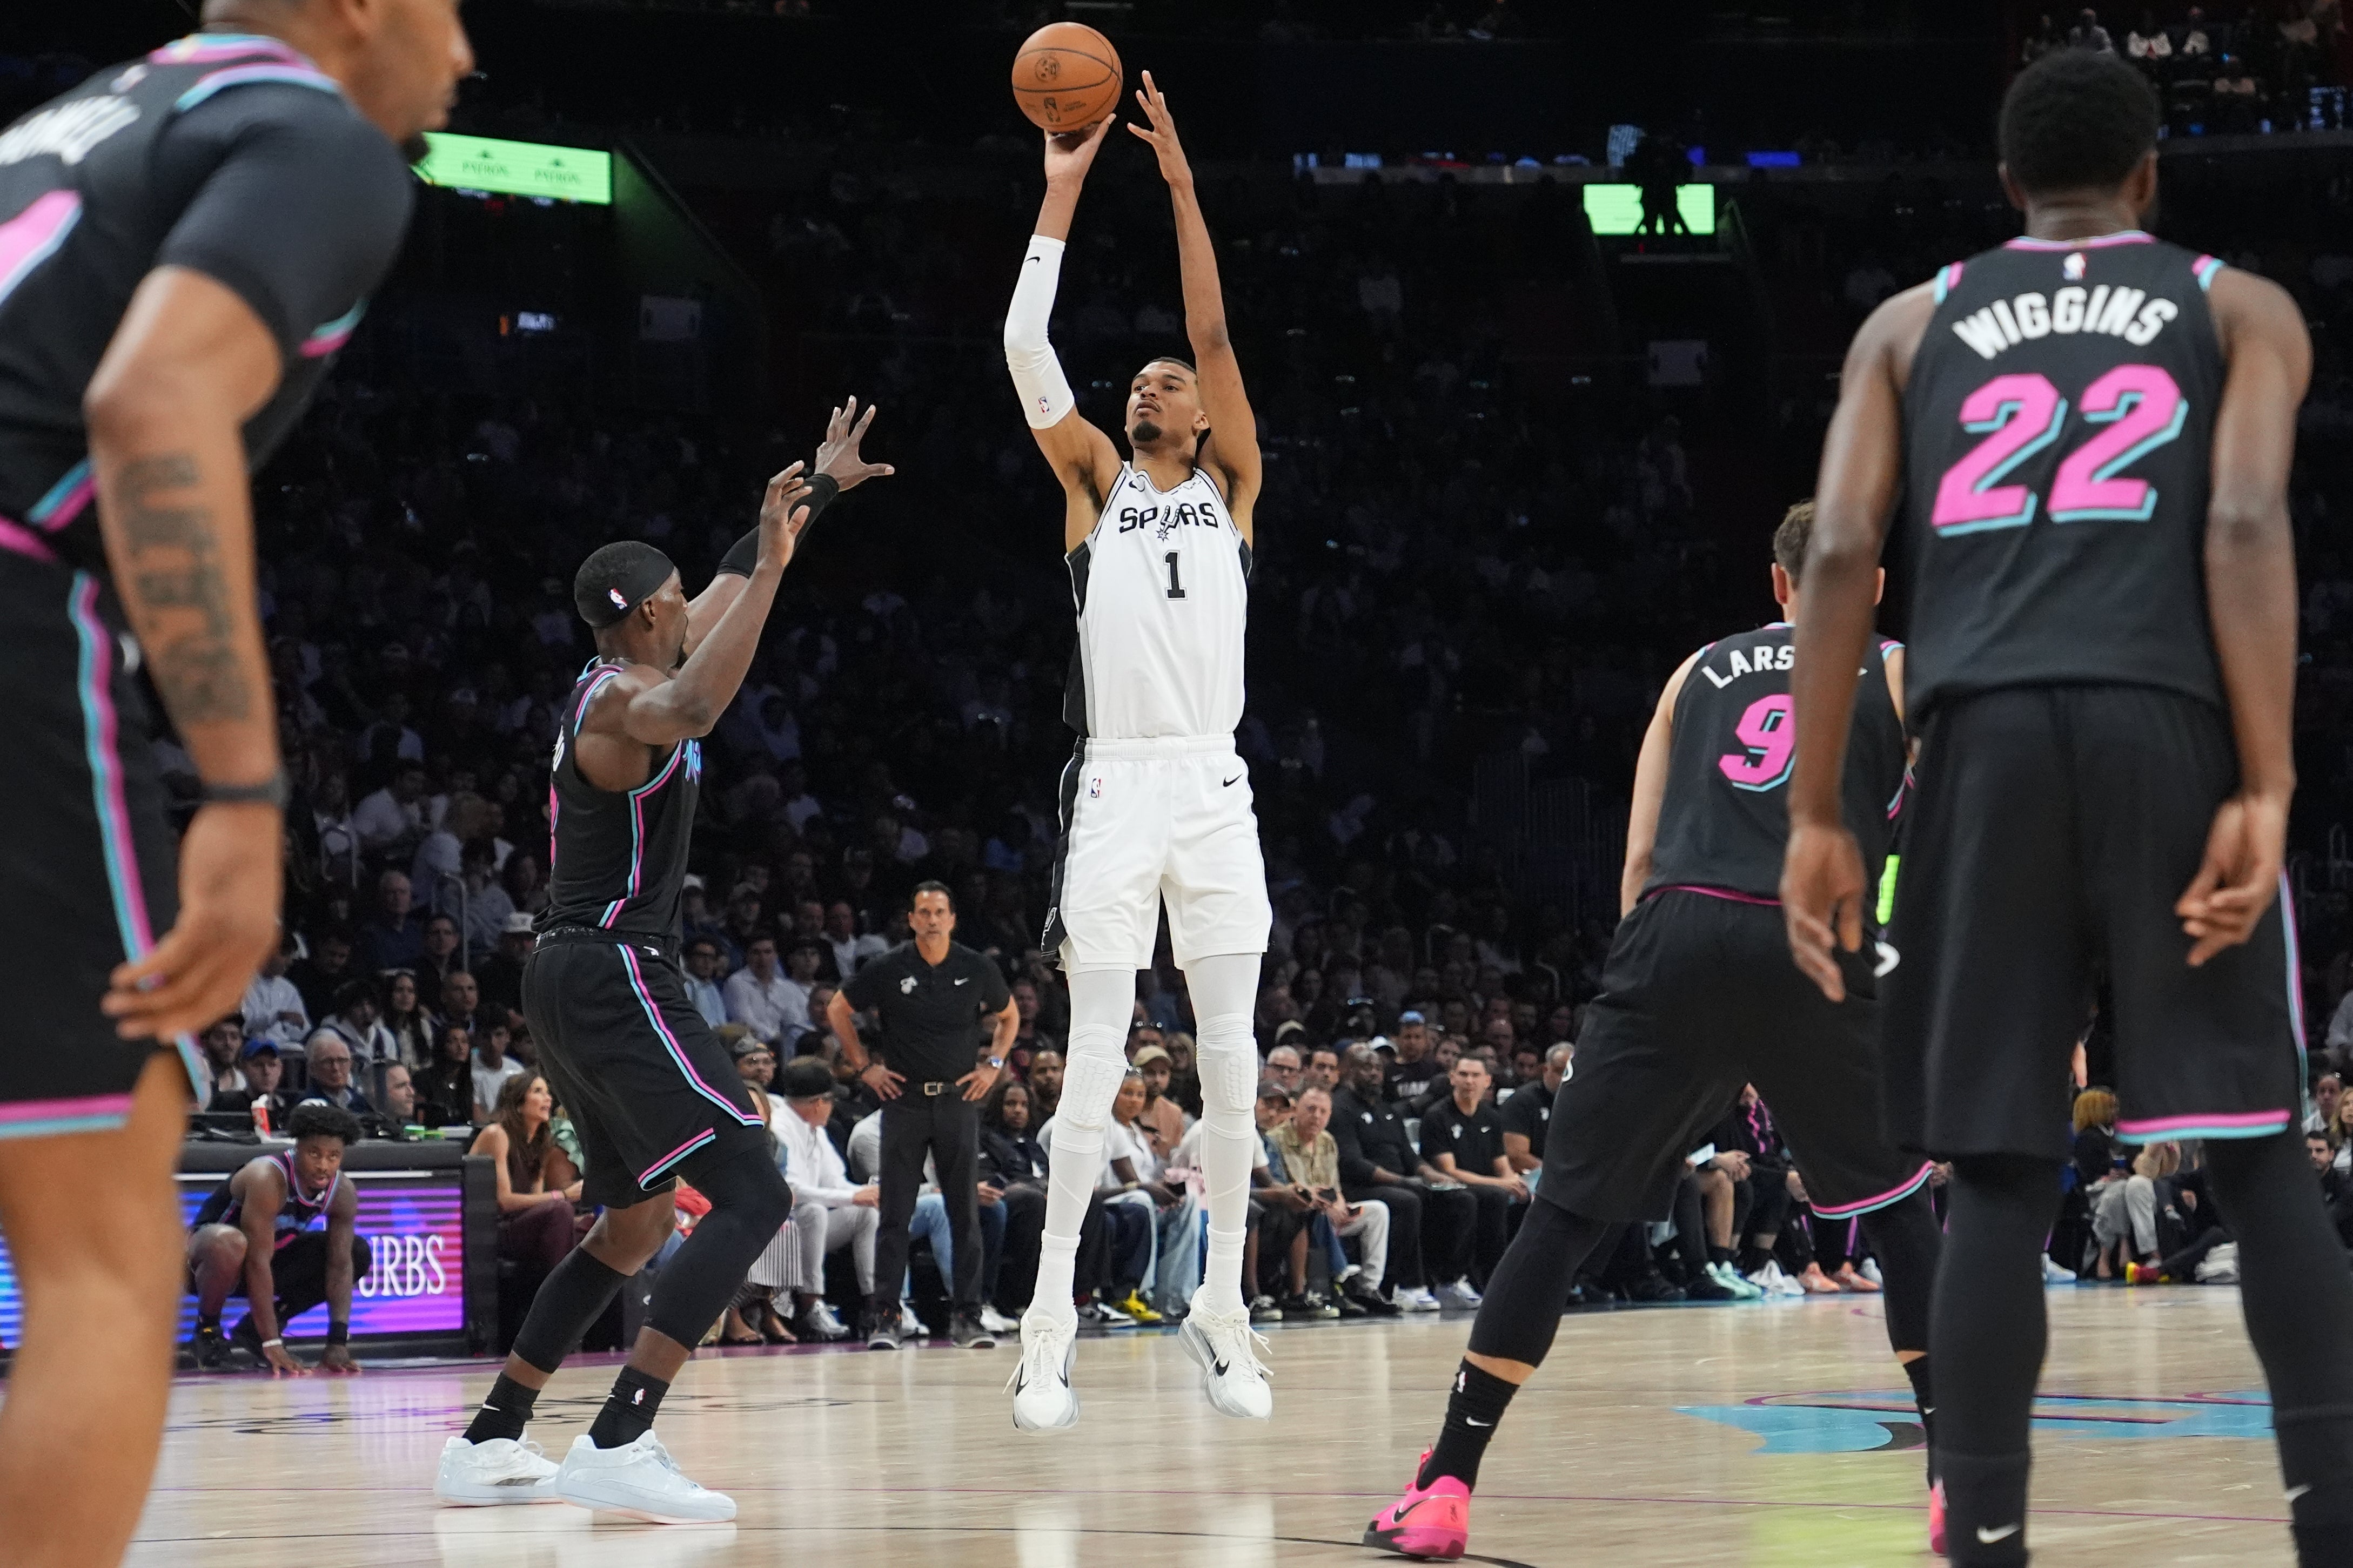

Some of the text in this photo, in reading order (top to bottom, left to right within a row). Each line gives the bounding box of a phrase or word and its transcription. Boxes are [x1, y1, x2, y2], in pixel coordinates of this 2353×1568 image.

[1952, 284, 2178, 360] WIGGINS
[1930, 364, 2189, 537] 22
[1119, 502, 1218, 542] SPURS
[1163, 550, 1188, 601] 1
[1718, 694, 1796, 792] 9
